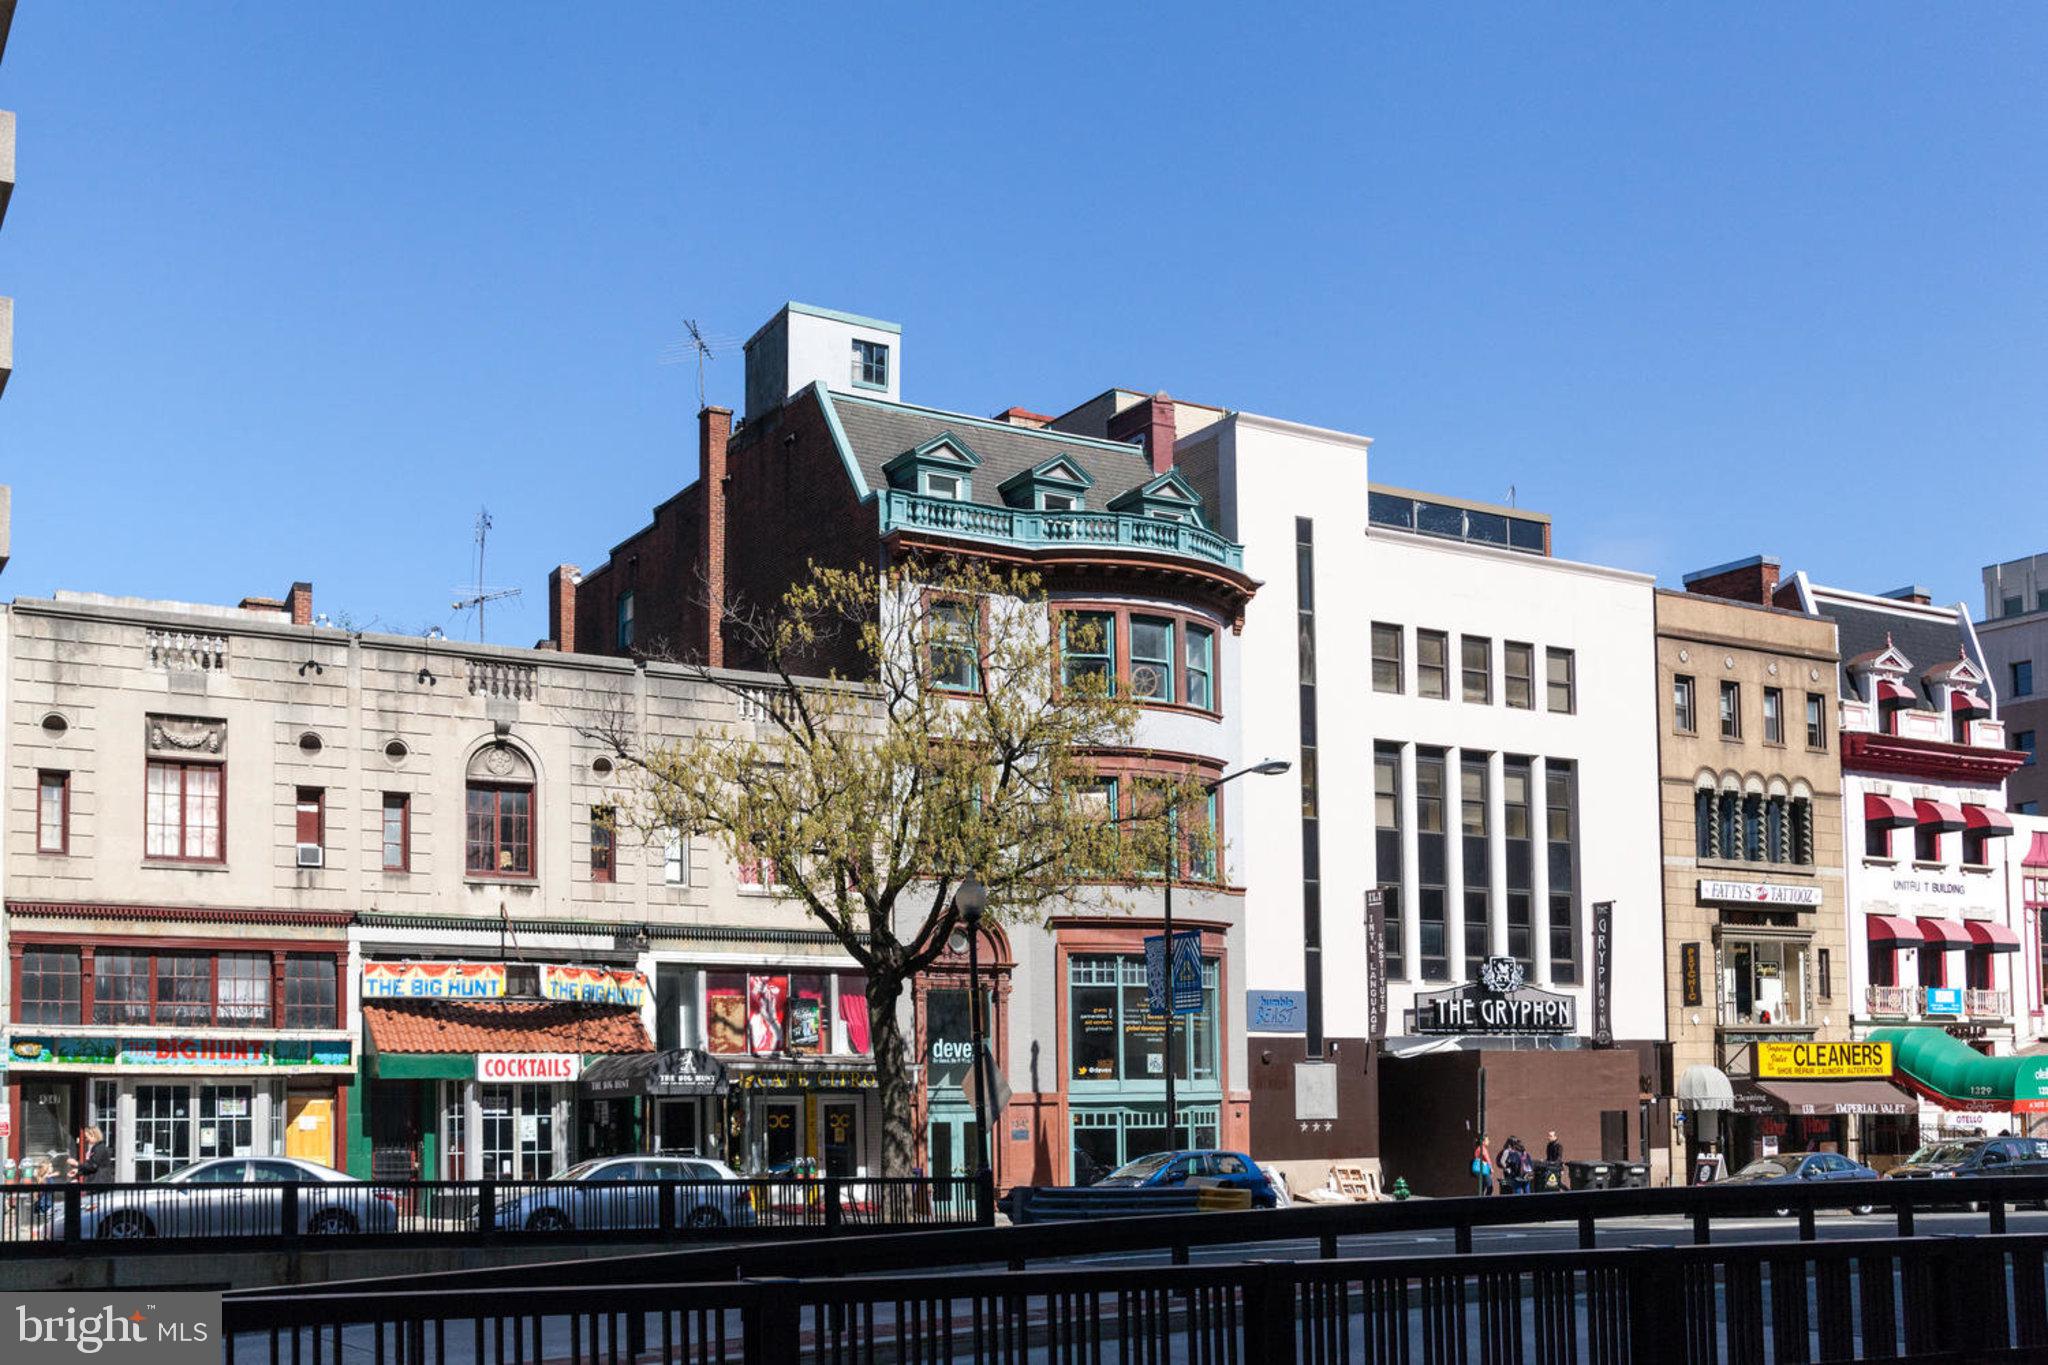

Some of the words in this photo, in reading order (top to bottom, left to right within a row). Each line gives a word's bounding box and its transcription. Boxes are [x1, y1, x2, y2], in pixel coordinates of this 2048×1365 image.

[1770, 887, 1813, 903] TATTOOZ
[1931, 882, 1966, 895] BUILDING
[1378, 933, 1386, 1013] INSTITUTE
[1598, 918, 1607, 1030] GRYPHON
[1686, 947, 1697, 1001] PSYCHIC
[366, 978, 404, 996] THE
[411, 978, 442, 996] BIG
[448, 978, 499, 997] HUNT
[550, 980, 577, 1000] THE
[582, 984, 605, 1002] BIG
[606, 986, 643, 1005] HUNT
[1369, 962, 1378, 1033] LANGUAGE
[1435, 999, 1474, 1025] THE
[1481, 1000, 1569, 1025] GRYPHON
[129, 1041, 153, 1057] THE
[155, 1038, 197, 1059] BIG
[201, 1039, 265, 1060] HUNT
[1793, 1044, 1883, 1067] CLEANERS
[484, 1058, 571, 1078] COCKTAILS
[660, 1074, 675, 1082] THE
[678, 1074, 693, 1082] BIG
[694, 1074, 715, 1082] HUNT
[1847, 1066, 1884, 1074] ALTERATIONS
[591, 1081, 602, 1090] THE
[603, 1080, 614, 1090] BIG
[614, 1079, 629, 1089] HUNT
[817, 1071, 876, 1088] CITRO
[1835, 1103, 1878, 1114] IMPERIAL
[1880, 1103, 1906, 1114] VALET
